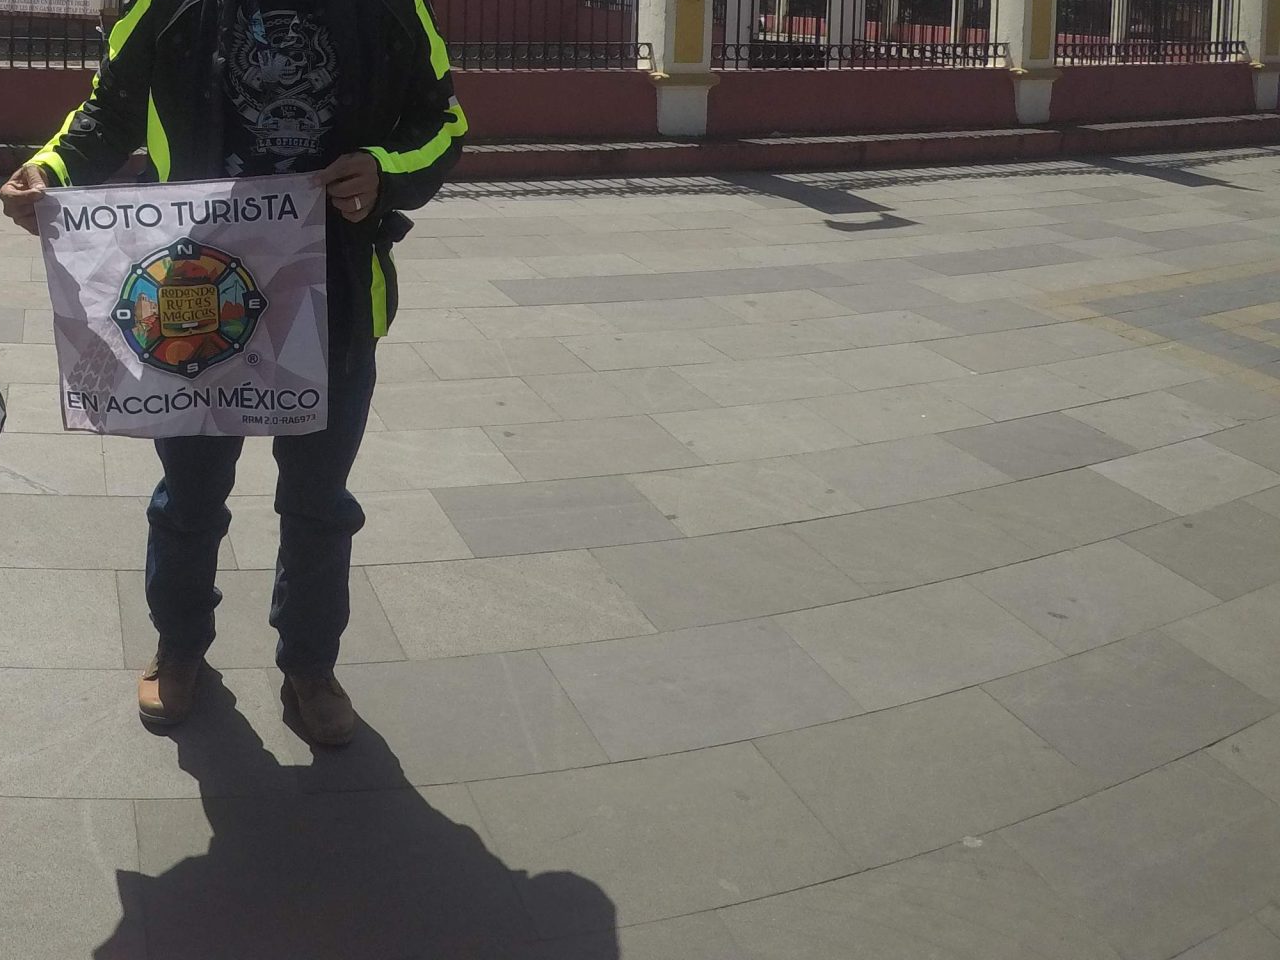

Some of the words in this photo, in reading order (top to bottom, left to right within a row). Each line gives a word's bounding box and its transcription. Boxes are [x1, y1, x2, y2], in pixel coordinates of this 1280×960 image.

[259, 139, 272, 147] LA
[276, 138, 316, 148] OFICIAL
[62, 203, 163, 231] MOTO
[170, 193, 299, 226] TURISTA
[177, 244, 193, 255] N
[248, 298, 261, 309] E
[116, 309, 131, 320] O
[186, 362, 199, 373] S
[66, 390, 99, 413] EN
[106, 387, 211, 415] ACCIÓN
[218, 381, 320, 410] MÉXICO
